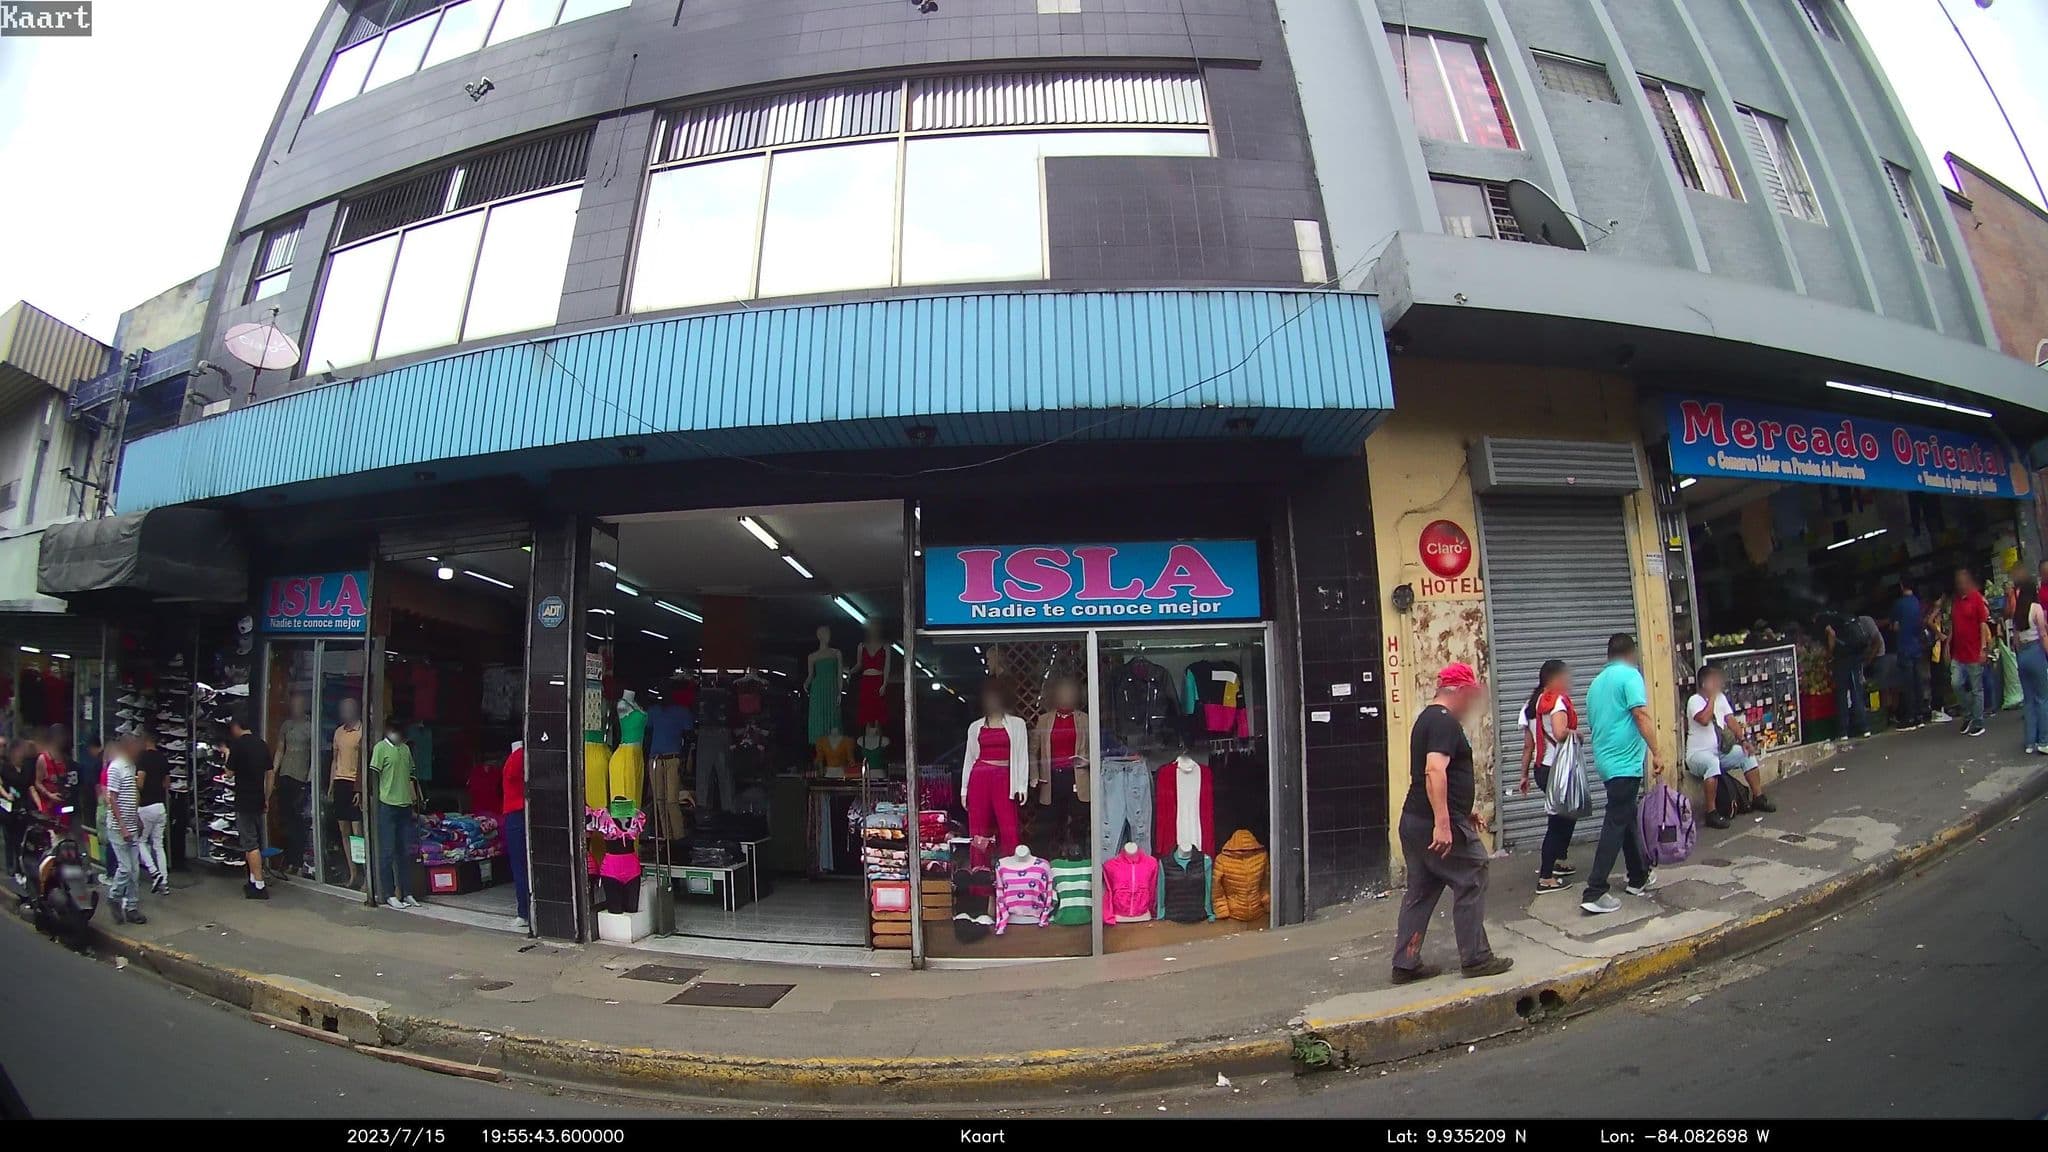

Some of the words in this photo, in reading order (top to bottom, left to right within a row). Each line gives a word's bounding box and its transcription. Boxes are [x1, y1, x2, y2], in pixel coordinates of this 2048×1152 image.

[1680, 400, 1879, 461] Mercado
[1892, 427, 2006, 476] Oriental
[1426, 541, 1464, 554] Claro
[957, 544, 1234, 603] ISLA
[267, 574, 367, 617] ISLA
[1421, 577, 1484, 596] HOTEL
[542, 605, 562, 617] ADT
[971, 604, 1039, 618] Nadie
[1042, 604, 1065, 617] te
[1071, 602, 1152, 616] conoce
[1159, 600, 1222, 616] mejor
[270, 618, 293, 628] Nadie
[294, 618, 301, 628] te
[303, 619, 333, 628] conoce
[335, 617, 361, 630] mejor
[1387, 636, 1401, 719] HOTEL
